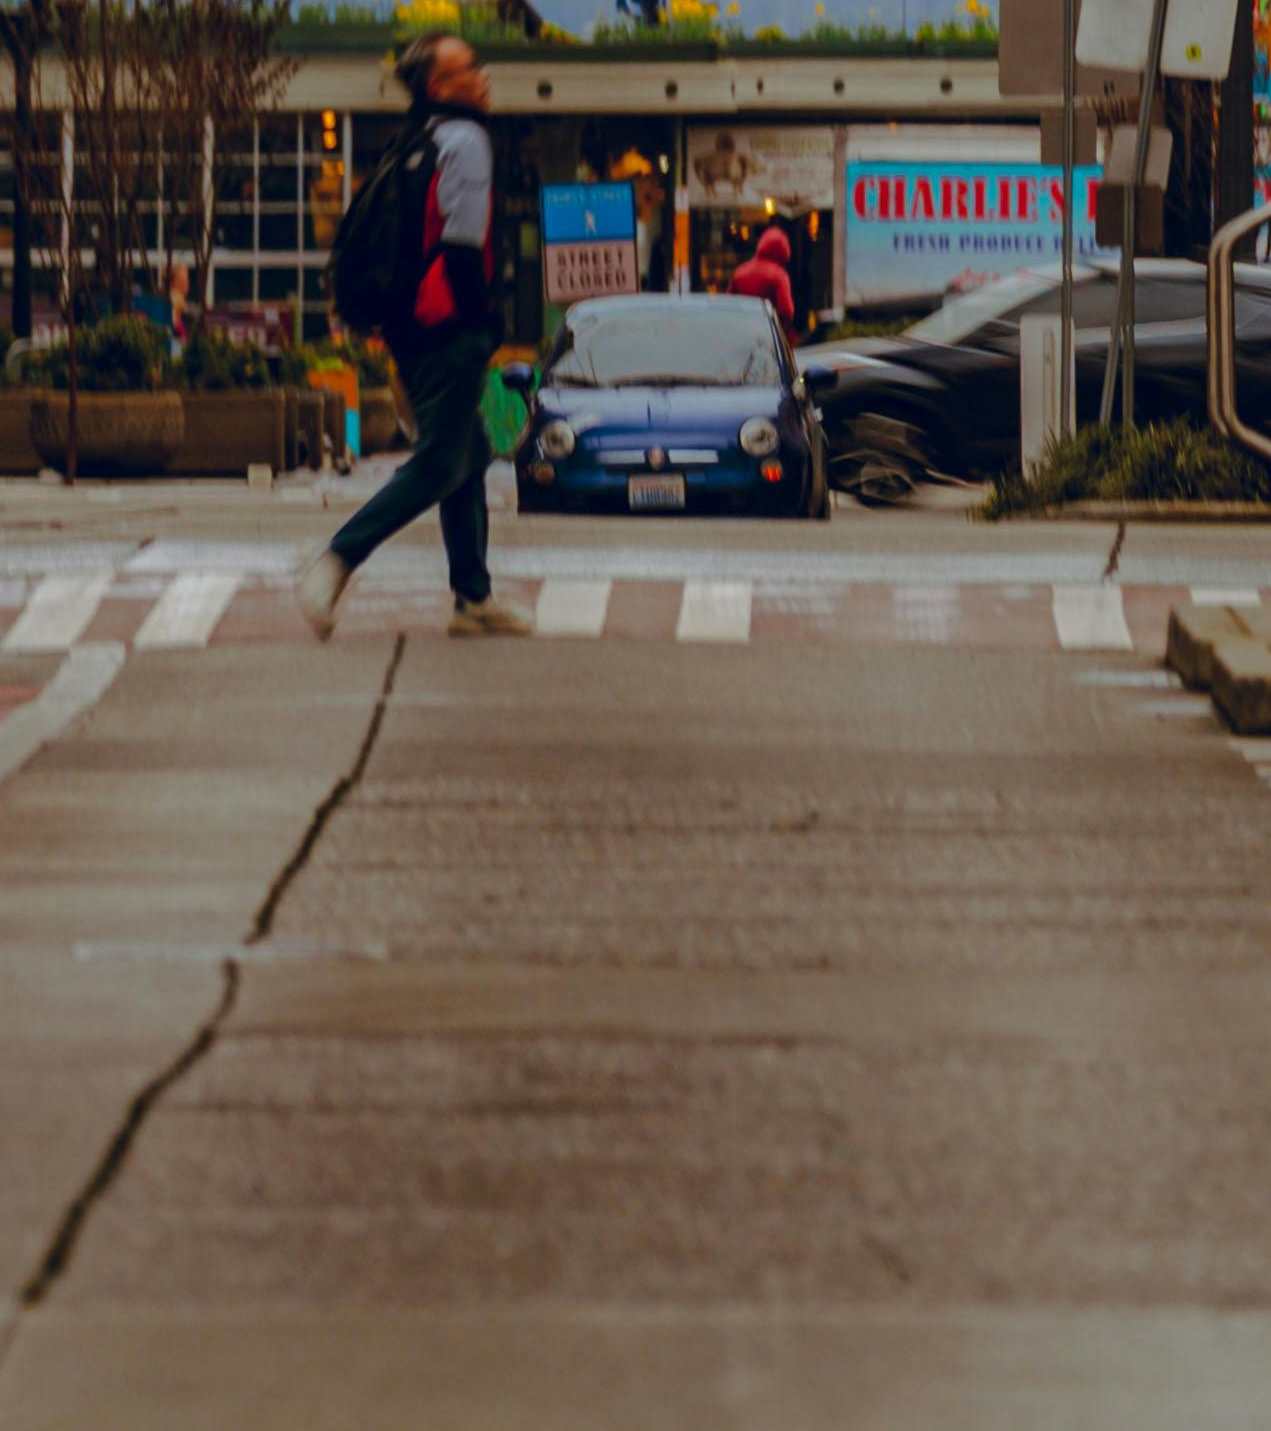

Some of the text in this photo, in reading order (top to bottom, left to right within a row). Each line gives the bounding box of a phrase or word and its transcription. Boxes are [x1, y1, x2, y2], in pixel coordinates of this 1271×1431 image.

[852, 175, 1066, 222] CHARLIE'S
[556, 247, 626, 268] STREET
[556, 271, 628, 290] CLOSED
